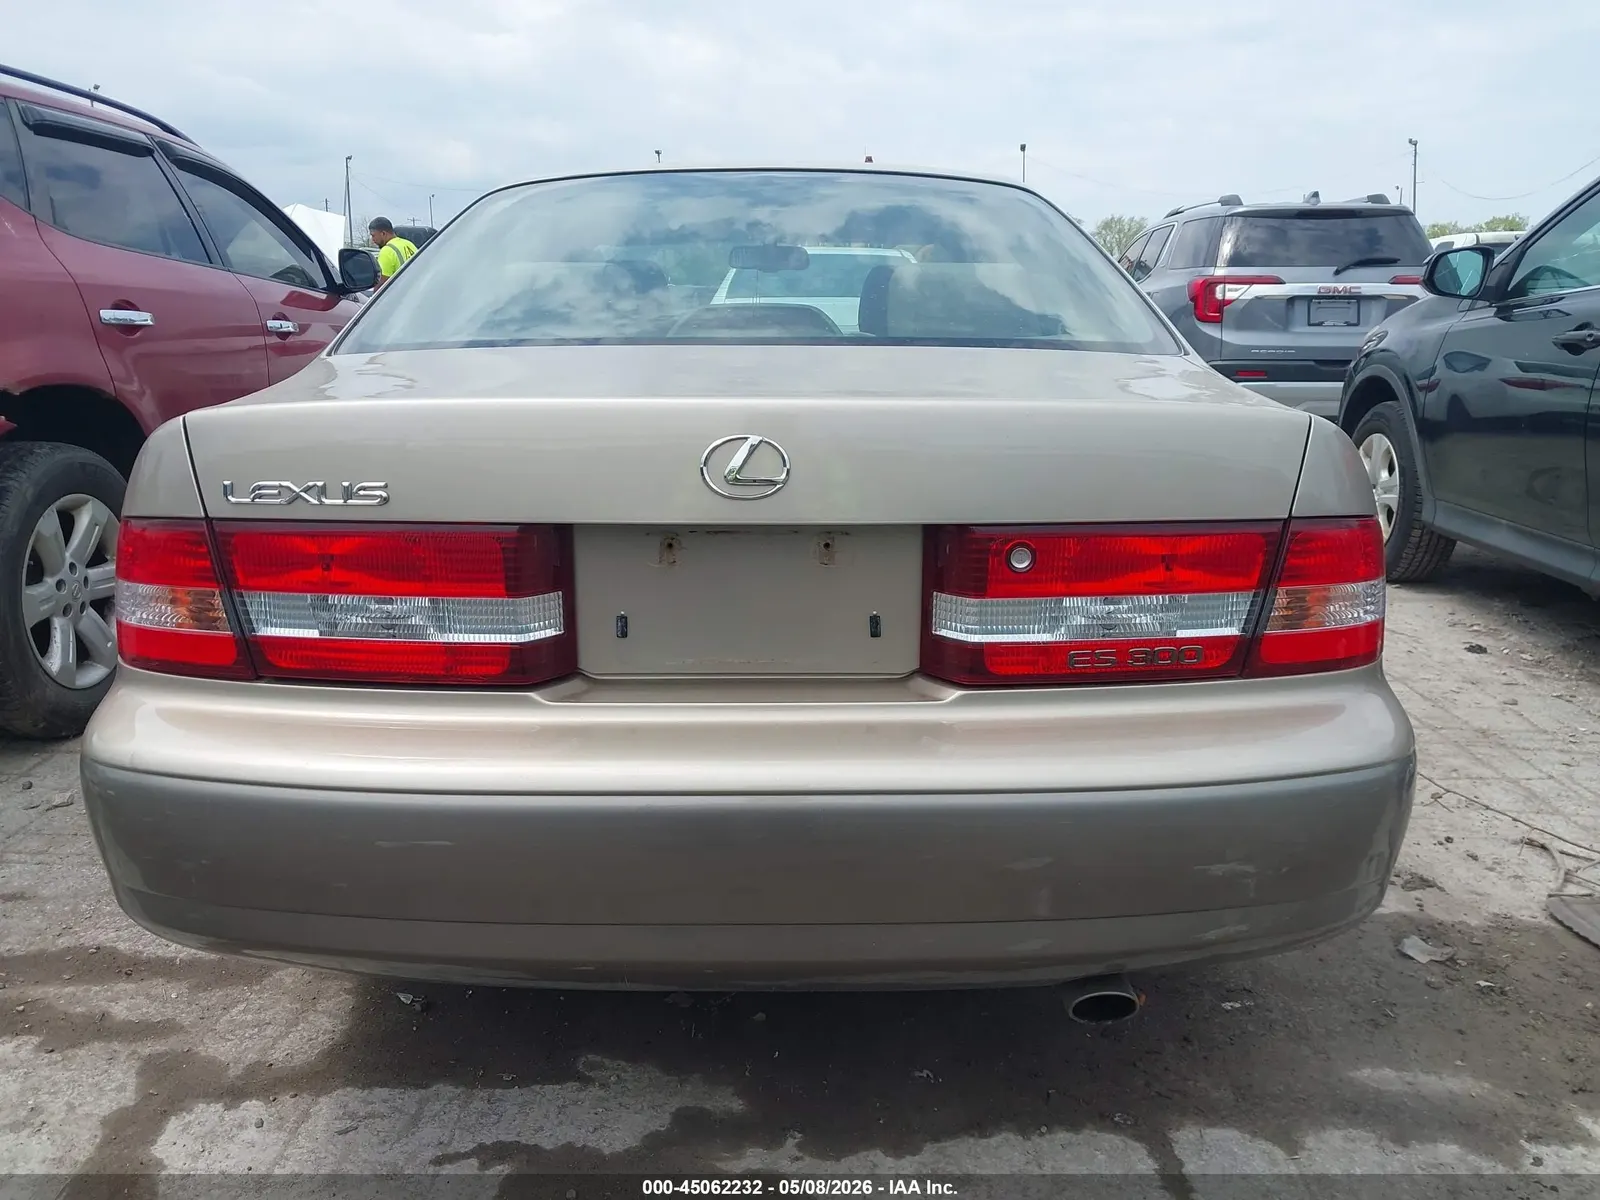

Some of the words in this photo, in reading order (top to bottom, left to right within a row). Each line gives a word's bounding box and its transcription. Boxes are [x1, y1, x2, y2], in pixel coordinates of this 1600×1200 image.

[1317, 285, 1362, 295] GMC
[222, 480, 390, 506] LEXUS
[1067, 649, 1117, 669] ES
[1127, 645, 1204, 667] 300
